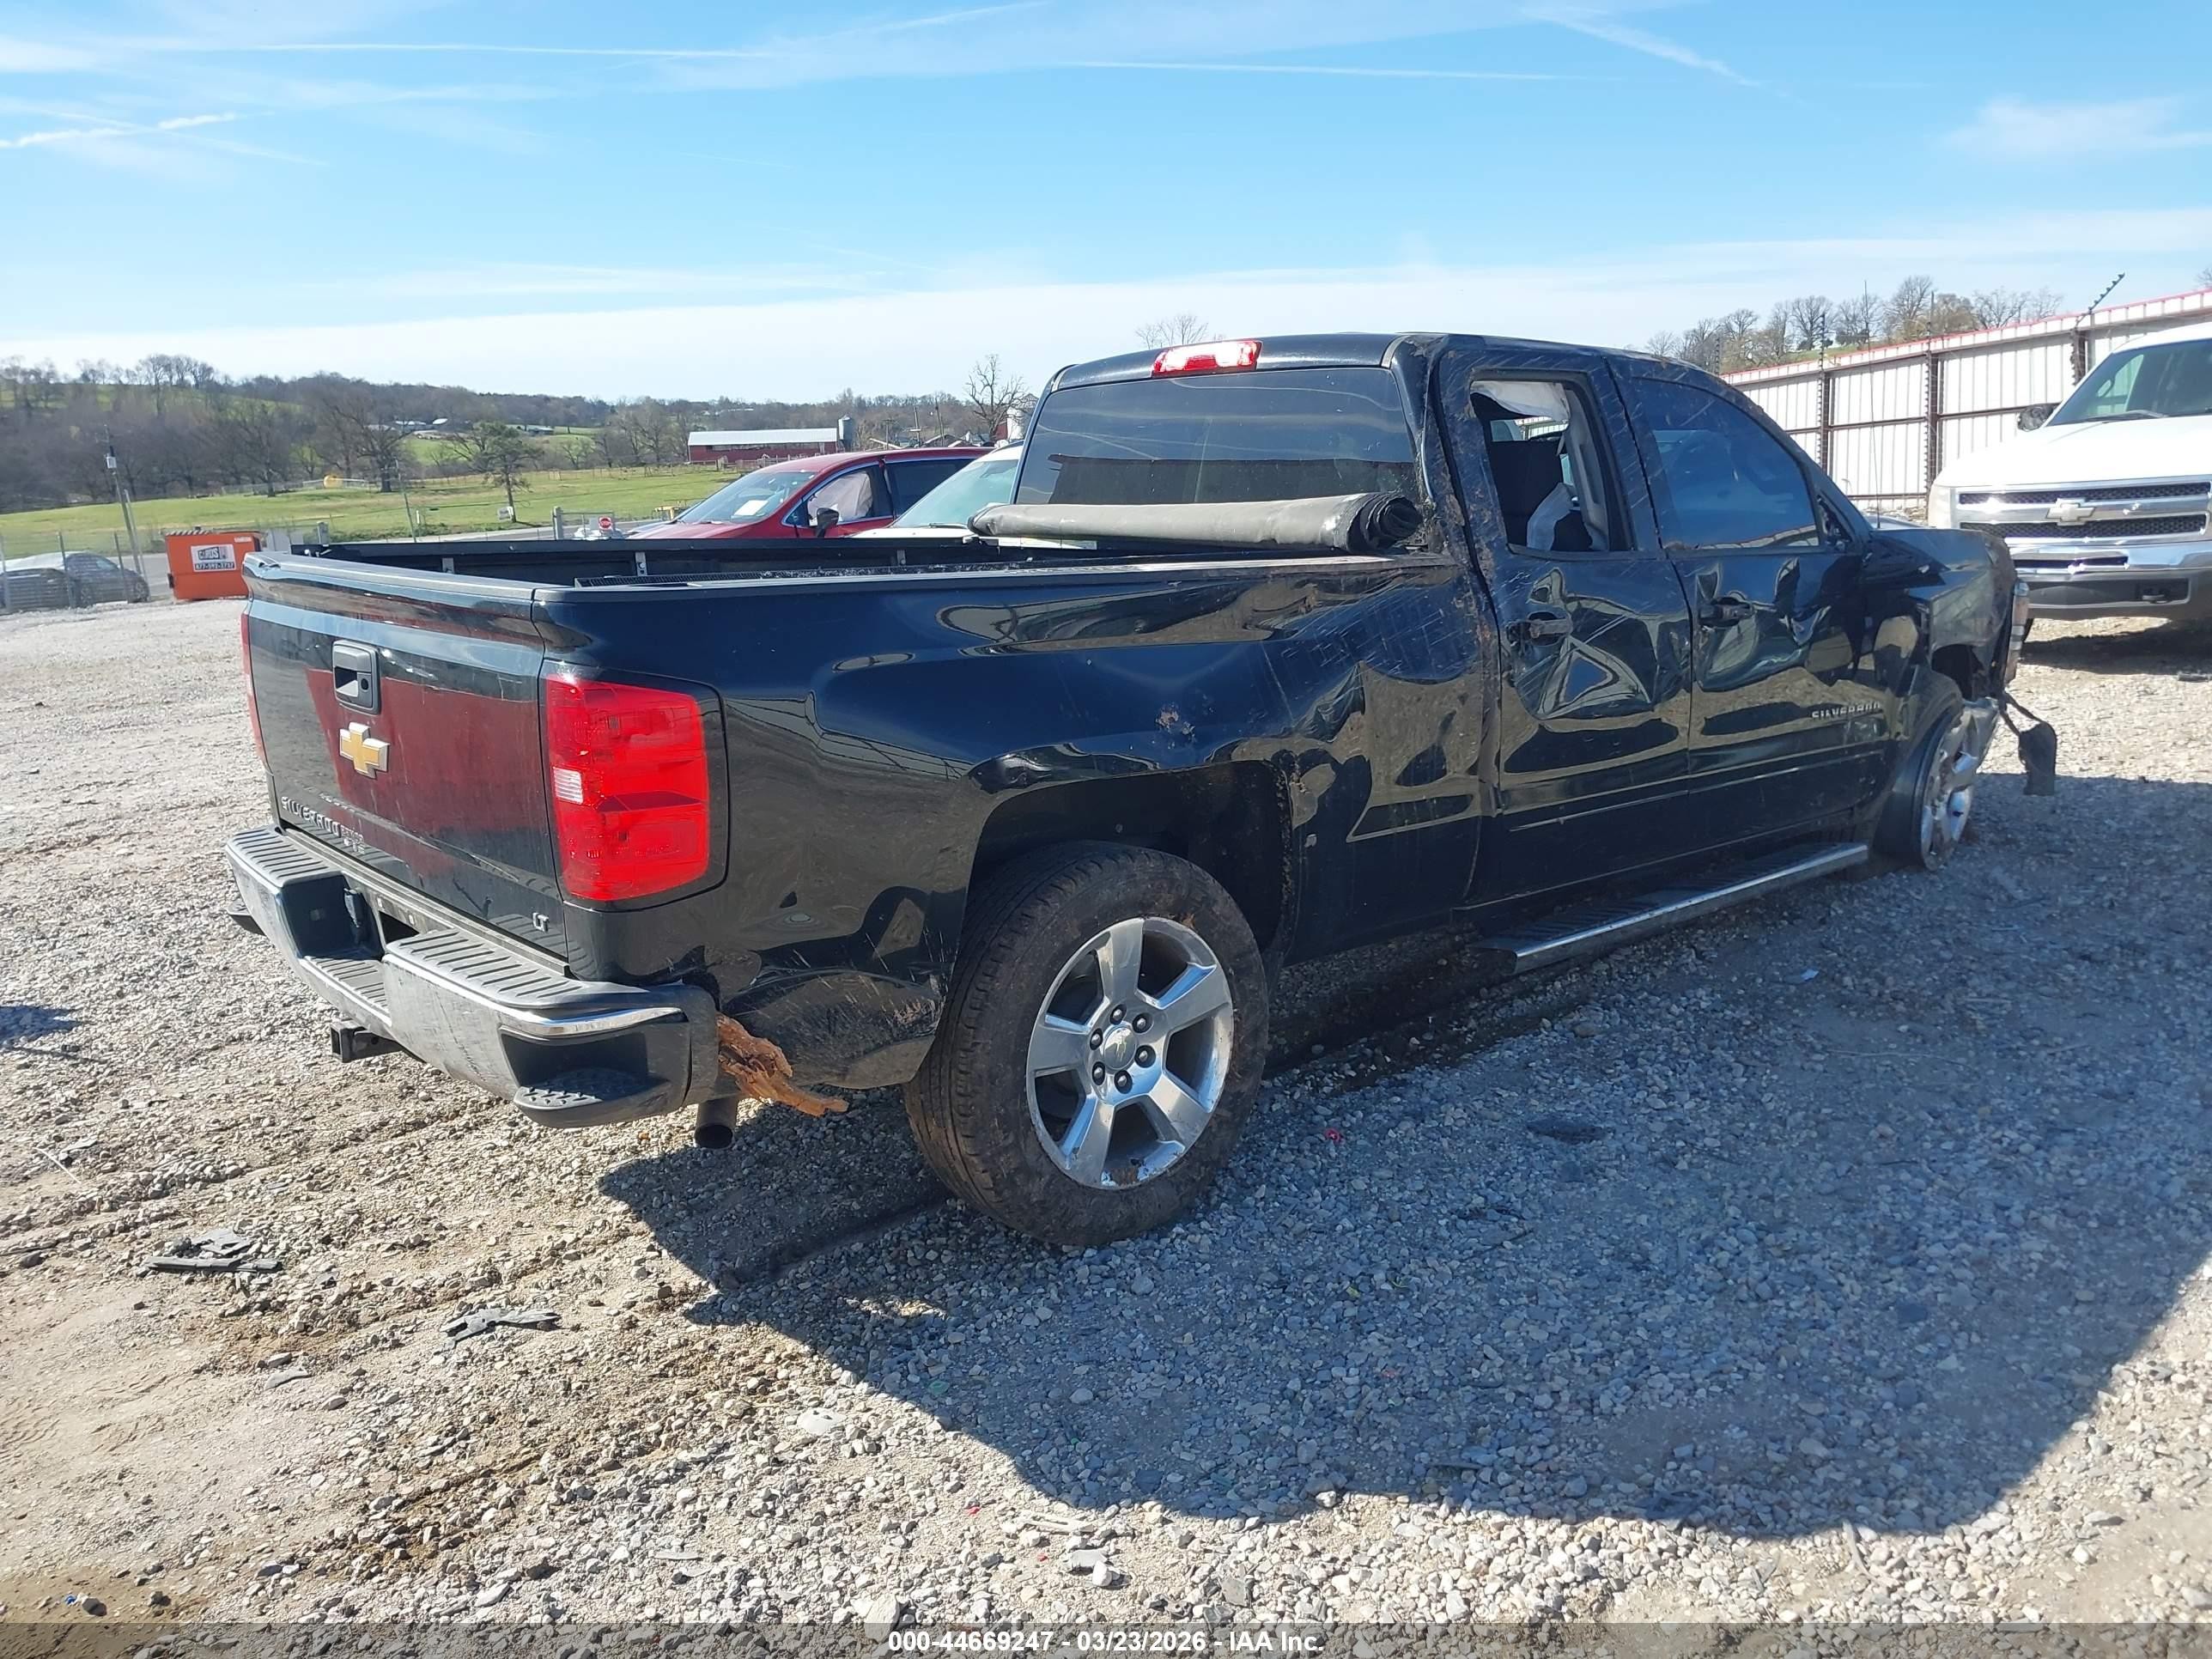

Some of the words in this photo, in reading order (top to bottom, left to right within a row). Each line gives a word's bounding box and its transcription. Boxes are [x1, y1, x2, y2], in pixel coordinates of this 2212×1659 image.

[1812, 701, 1881, 718] SILVERADO
[282, 796, 341, 836] SILVERADO
[532, 912, 550, 932] LT
